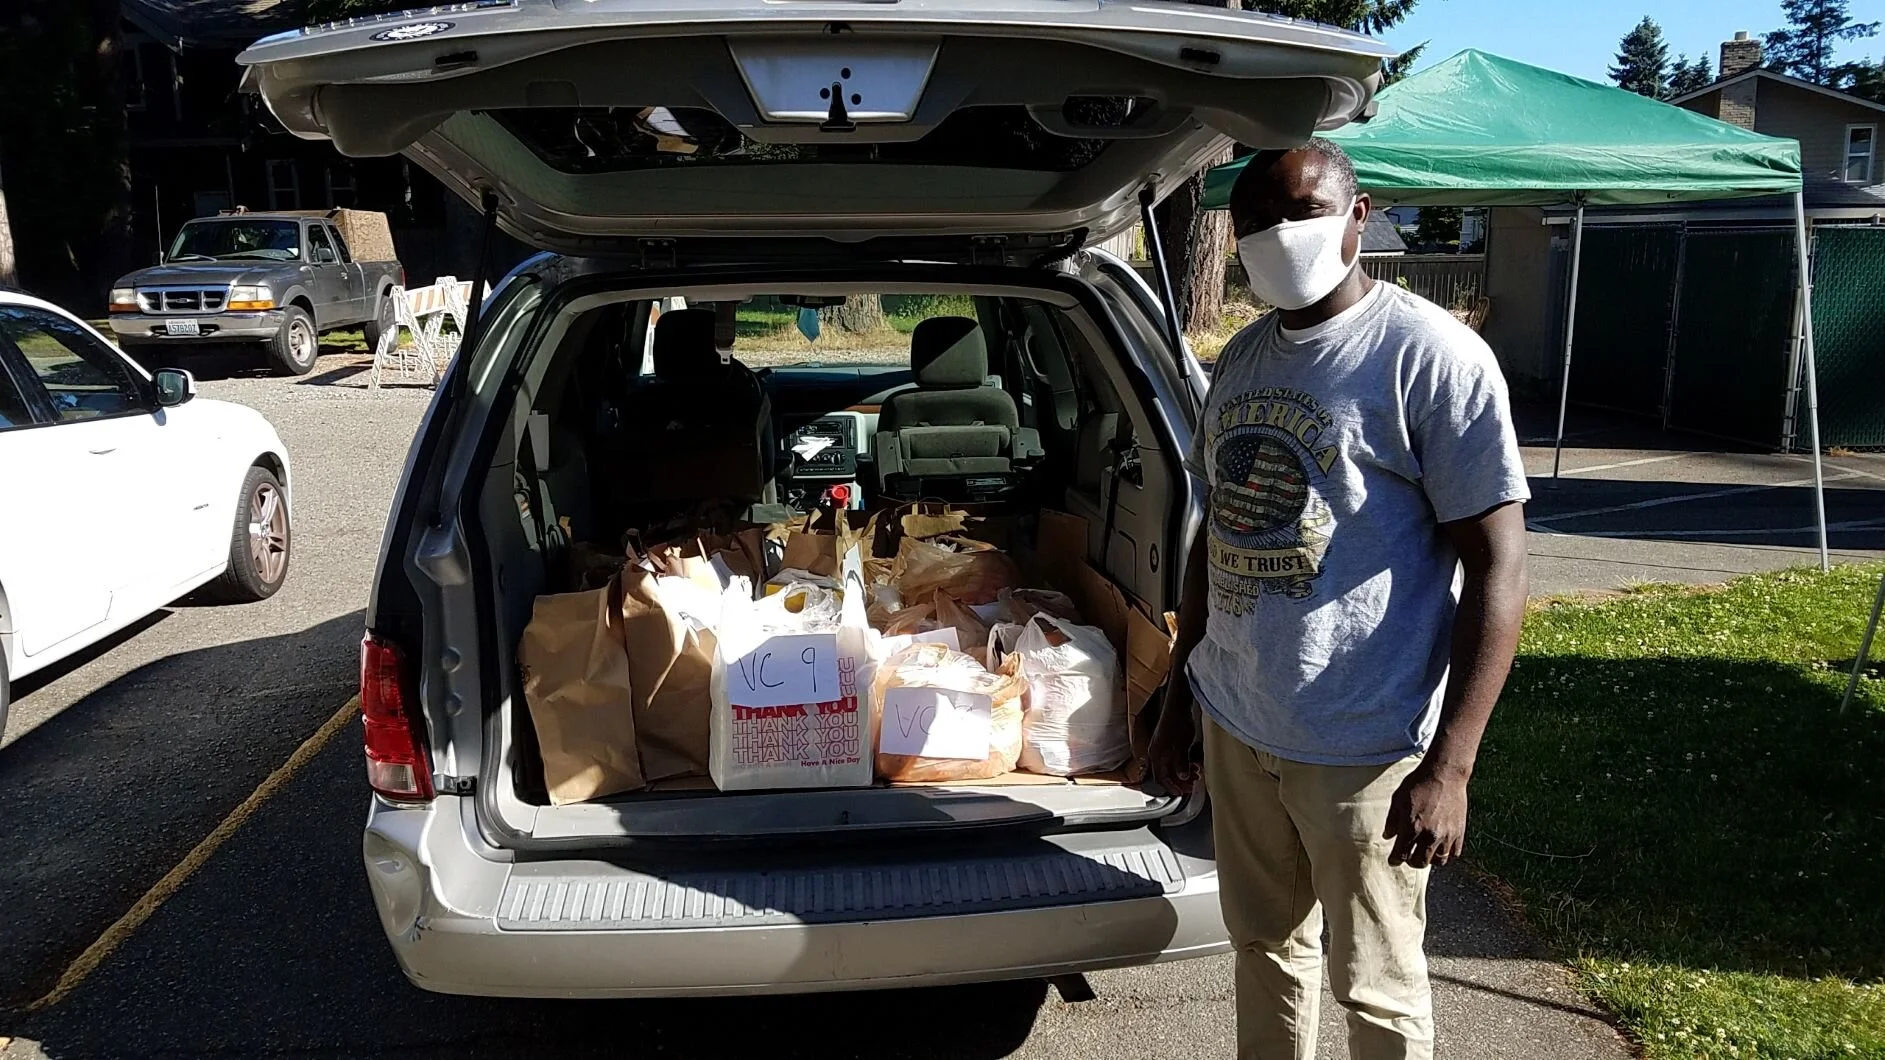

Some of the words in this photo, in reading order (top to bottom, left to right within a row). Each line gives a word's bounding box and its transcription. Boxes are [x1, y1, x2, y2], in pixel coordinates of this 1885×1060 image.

[1273, 387, 1319, 411] STATES
[1220, 549, 1239, 569] WE
[1244, 554, 1306, 572] TRUST
[738, 652, 784, 692] VC
[801, 646, 817, 693] 9
[731, 703, 808, 721] THANK
[816, 696, 858, 714] YOU
[733, 715, 808, 735] THANK
[815, 711, 858, 728] YOU
[733, 729, 809, 749] THANK
[815, 725, 859, 743] YOU
[733, 744, 810, 763] THANK
[816, 740, 860, 758] YOU
[801, 759, 819, 767] Have
[829, 758, 844, 766] Nice
[847, 757, 861, 766] Day
